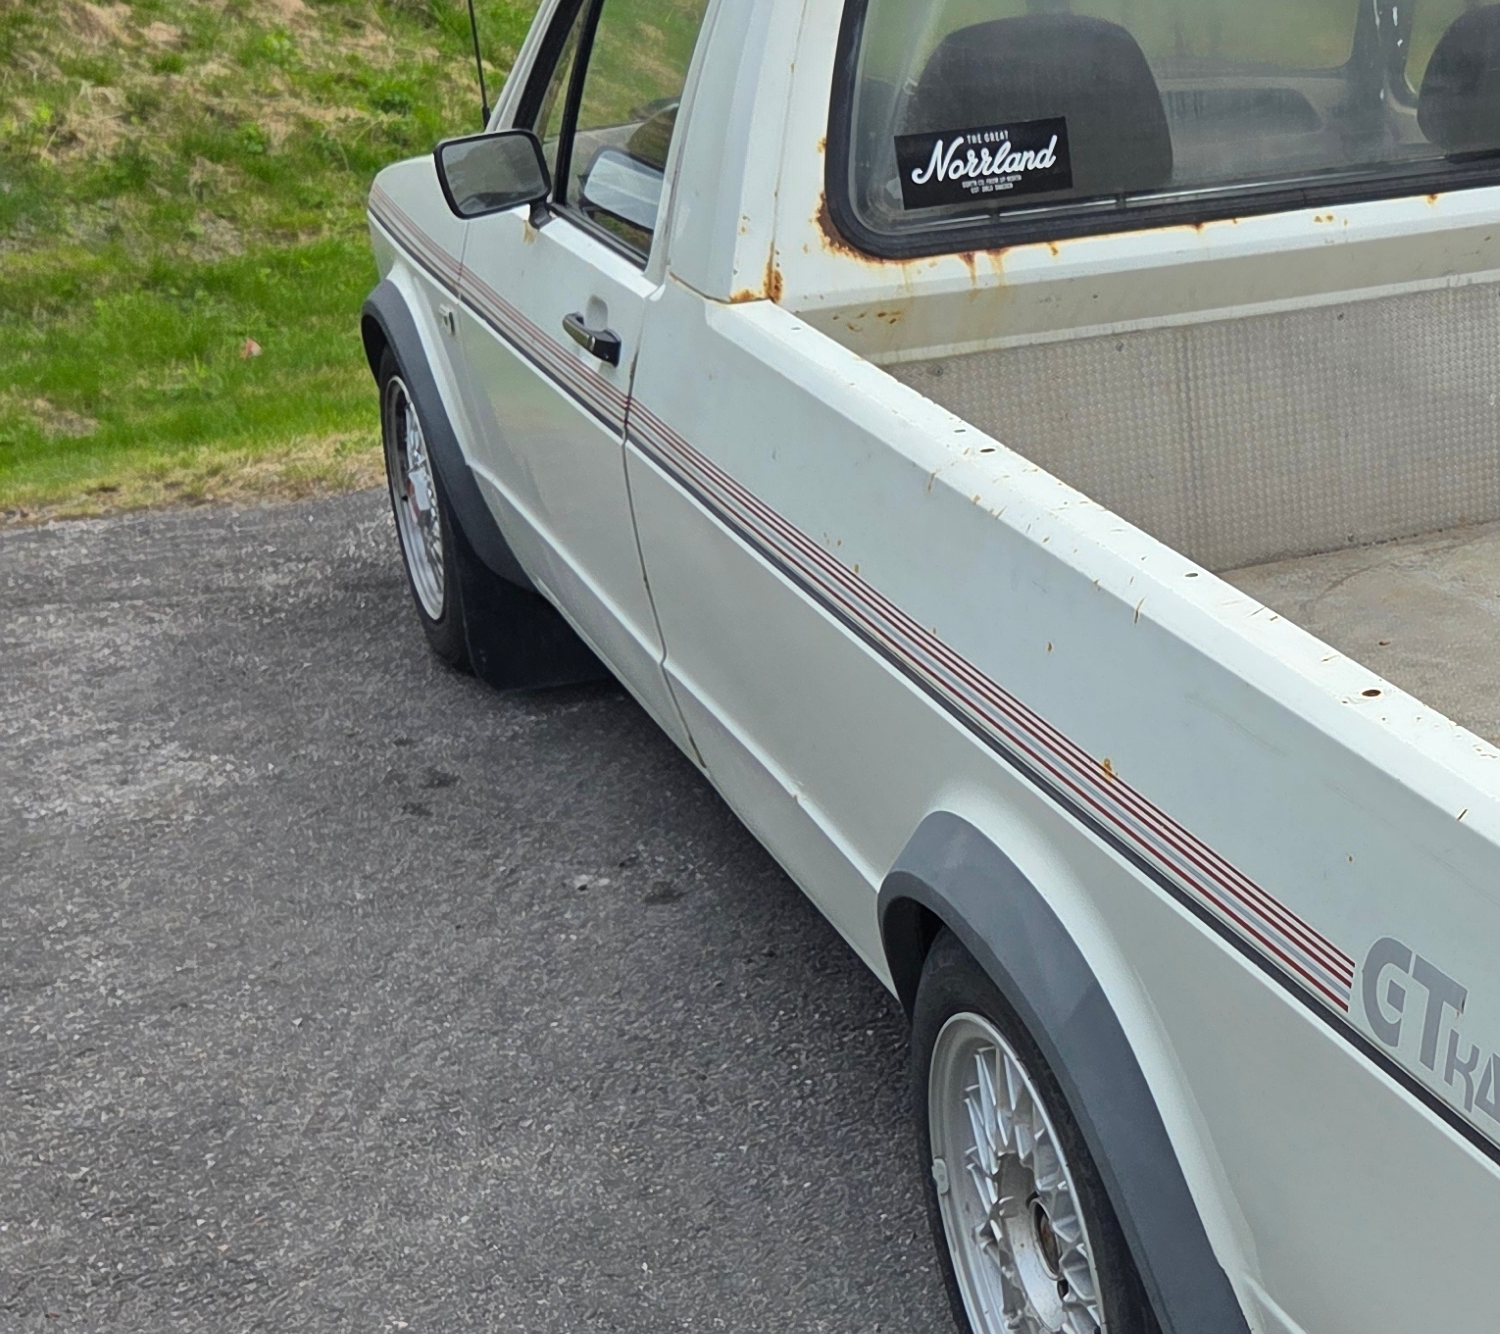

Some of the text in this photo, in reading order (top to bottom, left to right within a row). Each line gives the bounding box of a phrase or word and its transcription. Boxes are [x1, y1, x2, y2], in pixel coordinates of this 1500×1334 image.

[967, 129, 1009, 144] THE GREAT
[911, 134, 1057, 185] Norrland
